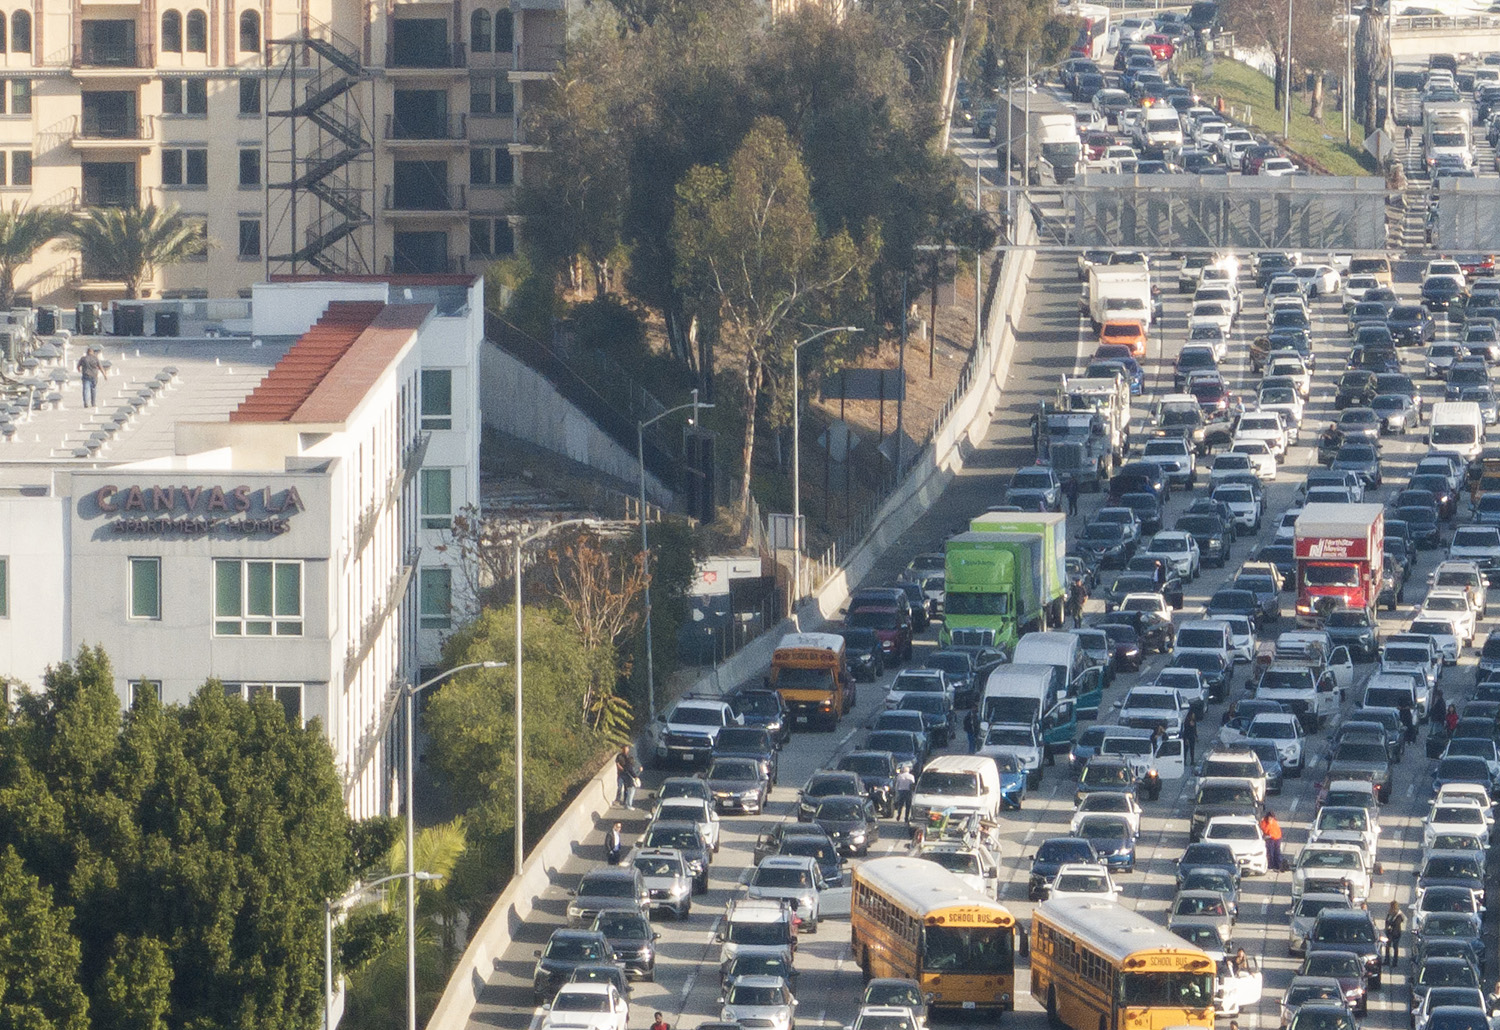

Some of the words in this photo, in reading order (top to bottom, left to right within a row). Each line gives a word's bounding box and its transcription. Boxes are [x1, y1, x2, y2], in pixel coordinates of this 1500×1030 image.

[96, 484, 252, 512] CANVAS
[263, 484, 306, 513] LA
[113, 518, 219, 534] APARTMENT
[227, 518, 292, 534] HOMES
[948, 912, 975, 923] SCHOOL
[977, 913, 990, 923] BUS
[1150, 956, 1173, 967] SCHOOL
[1175, 957, 1188, 967] BUS
